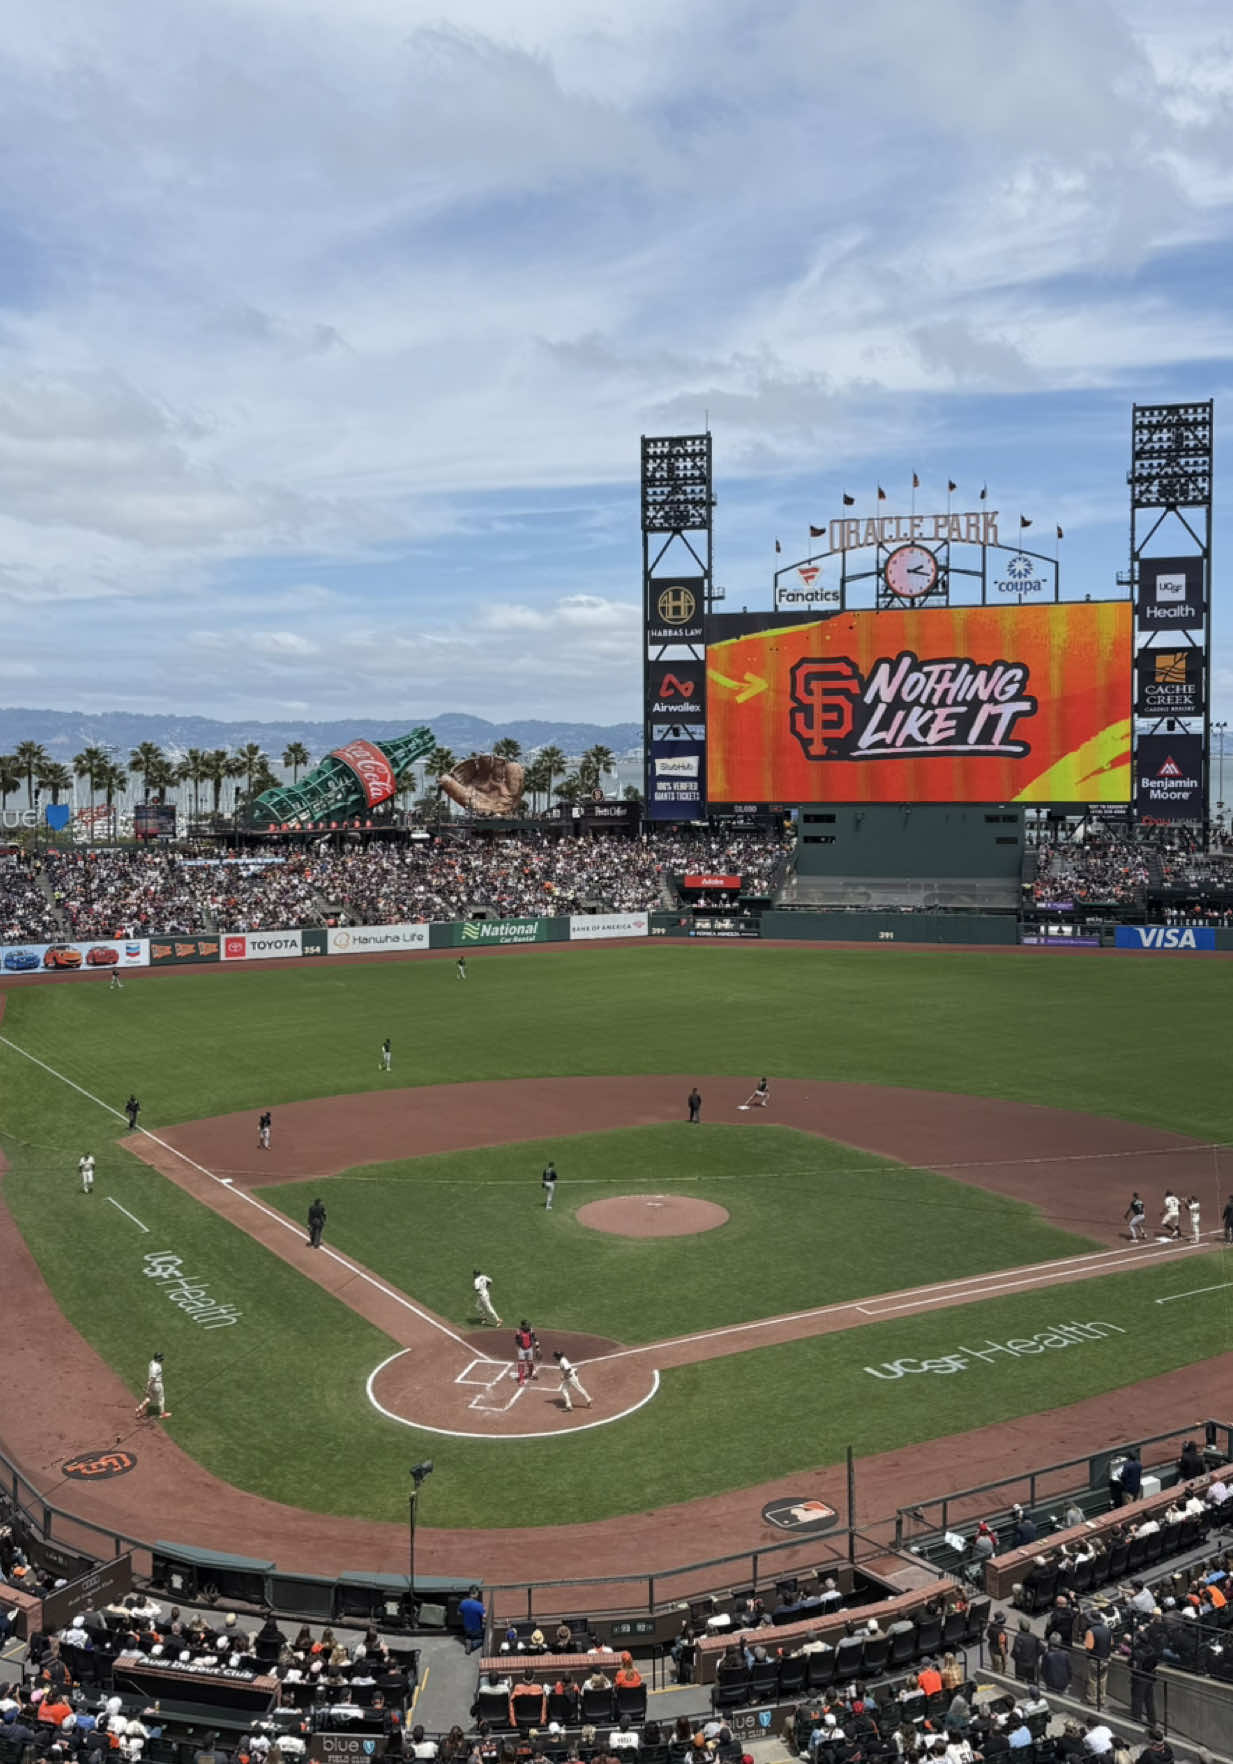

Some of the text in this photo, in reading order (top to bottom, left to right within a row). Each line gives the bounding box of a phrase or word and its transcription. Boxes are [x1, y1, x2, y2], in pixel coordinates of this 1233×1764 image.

[829, 511, 998, 553] ORACLE PARK
[998, 580, 1042, 595] coupa
[778, 588, 840, 603] Fanatics
[1146, 605, 1195, 618] Health
[651, 628, 702, 637] HABBAS LAW
[864, 656, 1024, 706] NOTHING
[1144, 684, 1196, 695] CACHE
[652, 702, 701, 713] Airwallex
[1145, 695, 1193, 705] CREEK
[857, 701, 1032, 749] LIKE IT
[1141, 777, 1197, 790] Benjamin
[1149, 789, 1191, 800] Moore
[480, 921, 538, 937] National
[251, 939, 298, 950] TOYOTA
[353, 933, 424, 945] Hanwha Life
[1134, 928, 1196, 948] VISA
[156, 1276, 243, 1330] Health
[864, 1321, 1126, 1379] UCSF Health
[139, 1656, 254, 1679] Audi Dugout Club
[323, 1736, 359, 1752] blue
